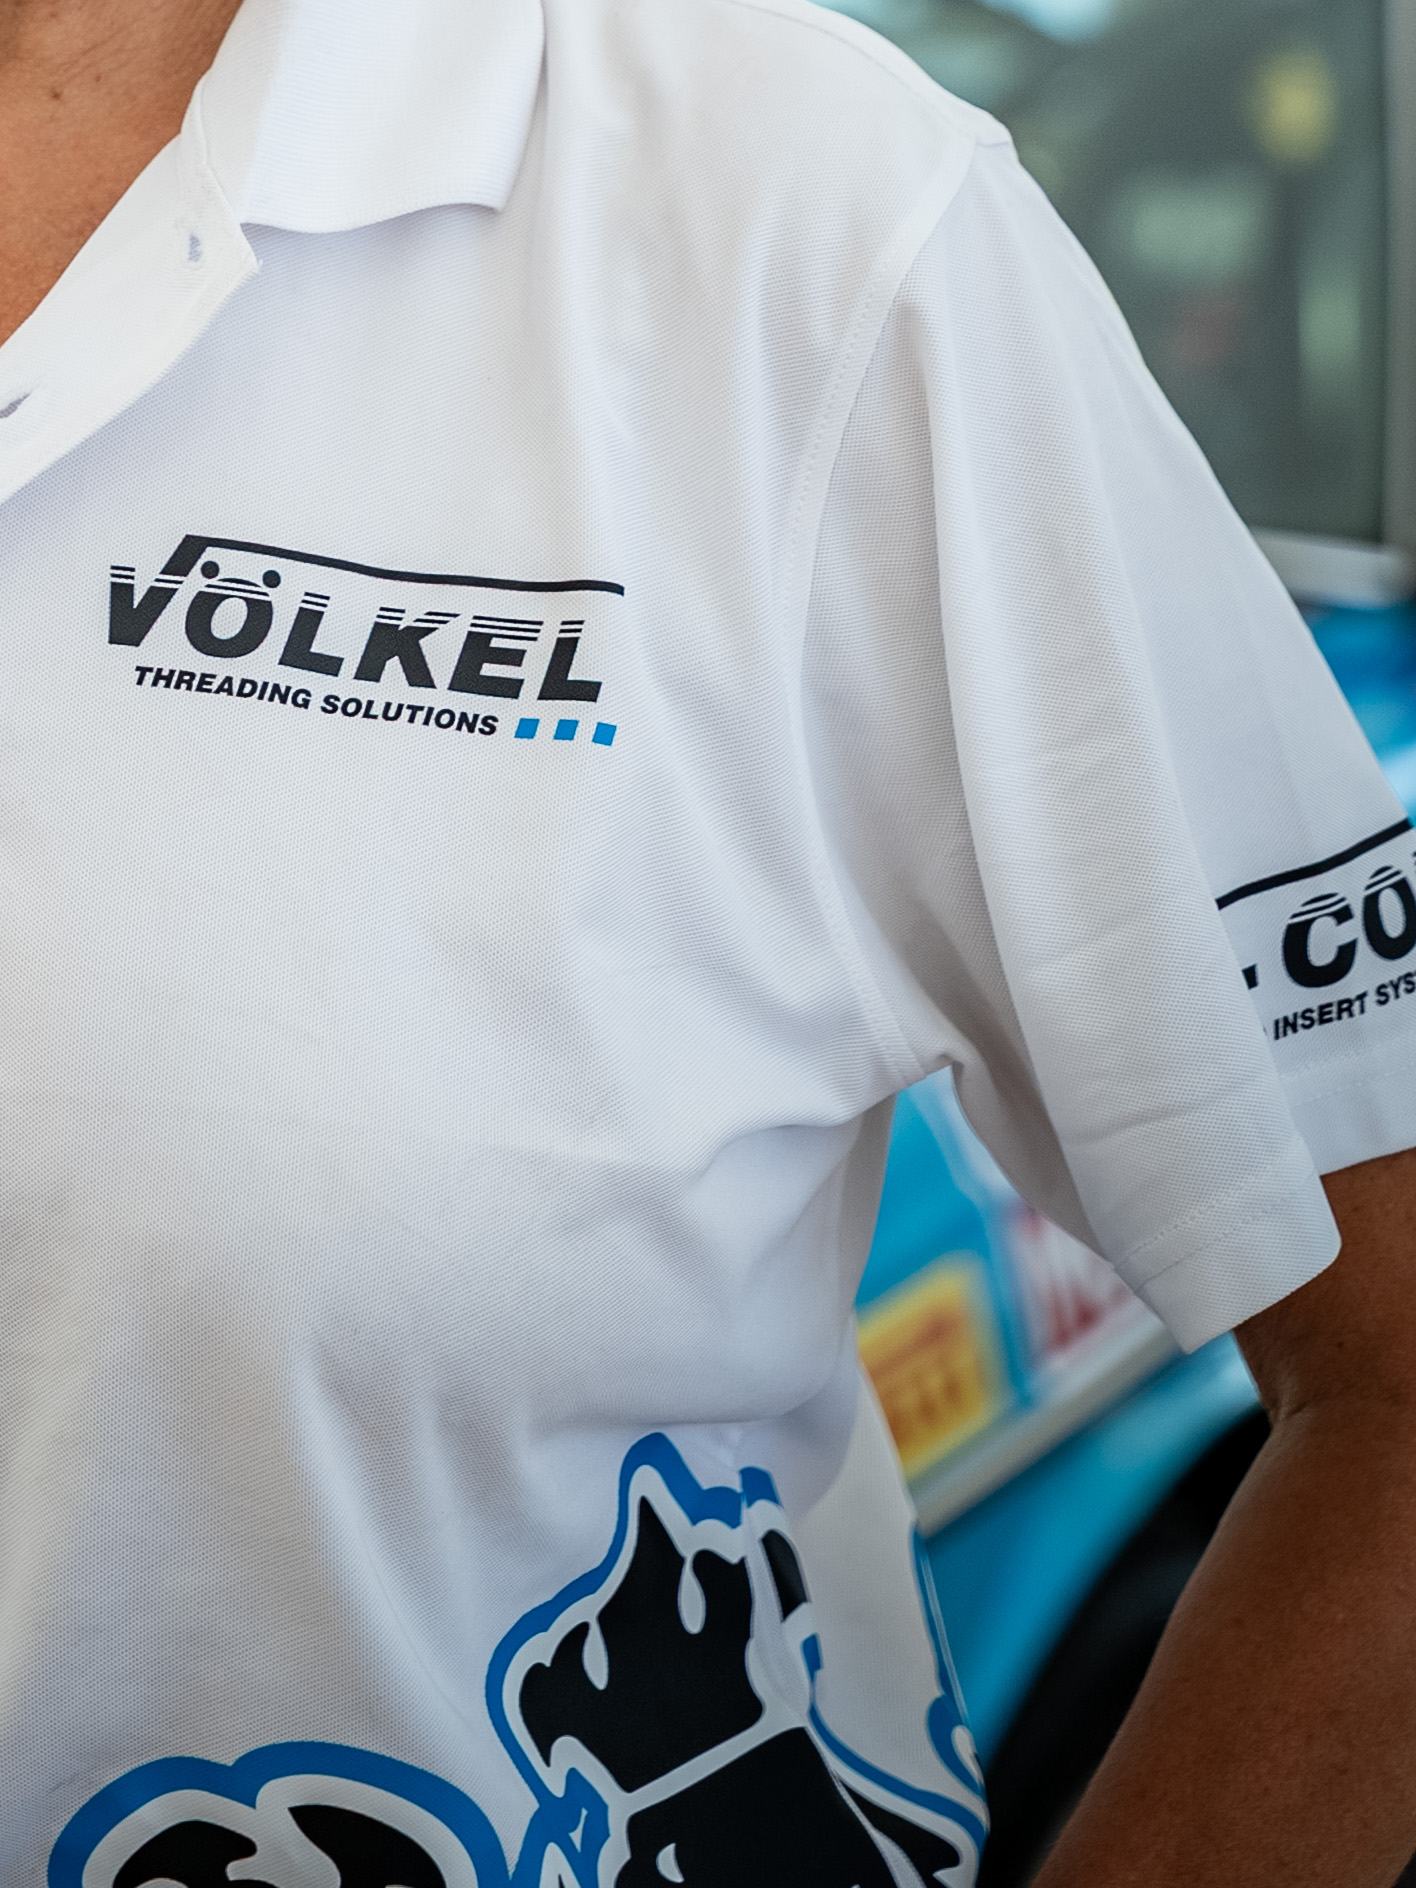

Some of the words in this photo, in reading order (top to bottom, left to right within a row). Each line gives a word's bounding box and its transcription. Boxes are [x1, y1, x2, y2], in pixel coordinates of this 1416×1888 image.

[108, 542, 603, 703] VÖLKEL
[134, 665, 312, 710] THREADING
[320, 694, 500, 737] SOLUTIONS
[1273, 990, 1369, 1041] INSERT
[1374, 969, 1416, 1006] SYS
